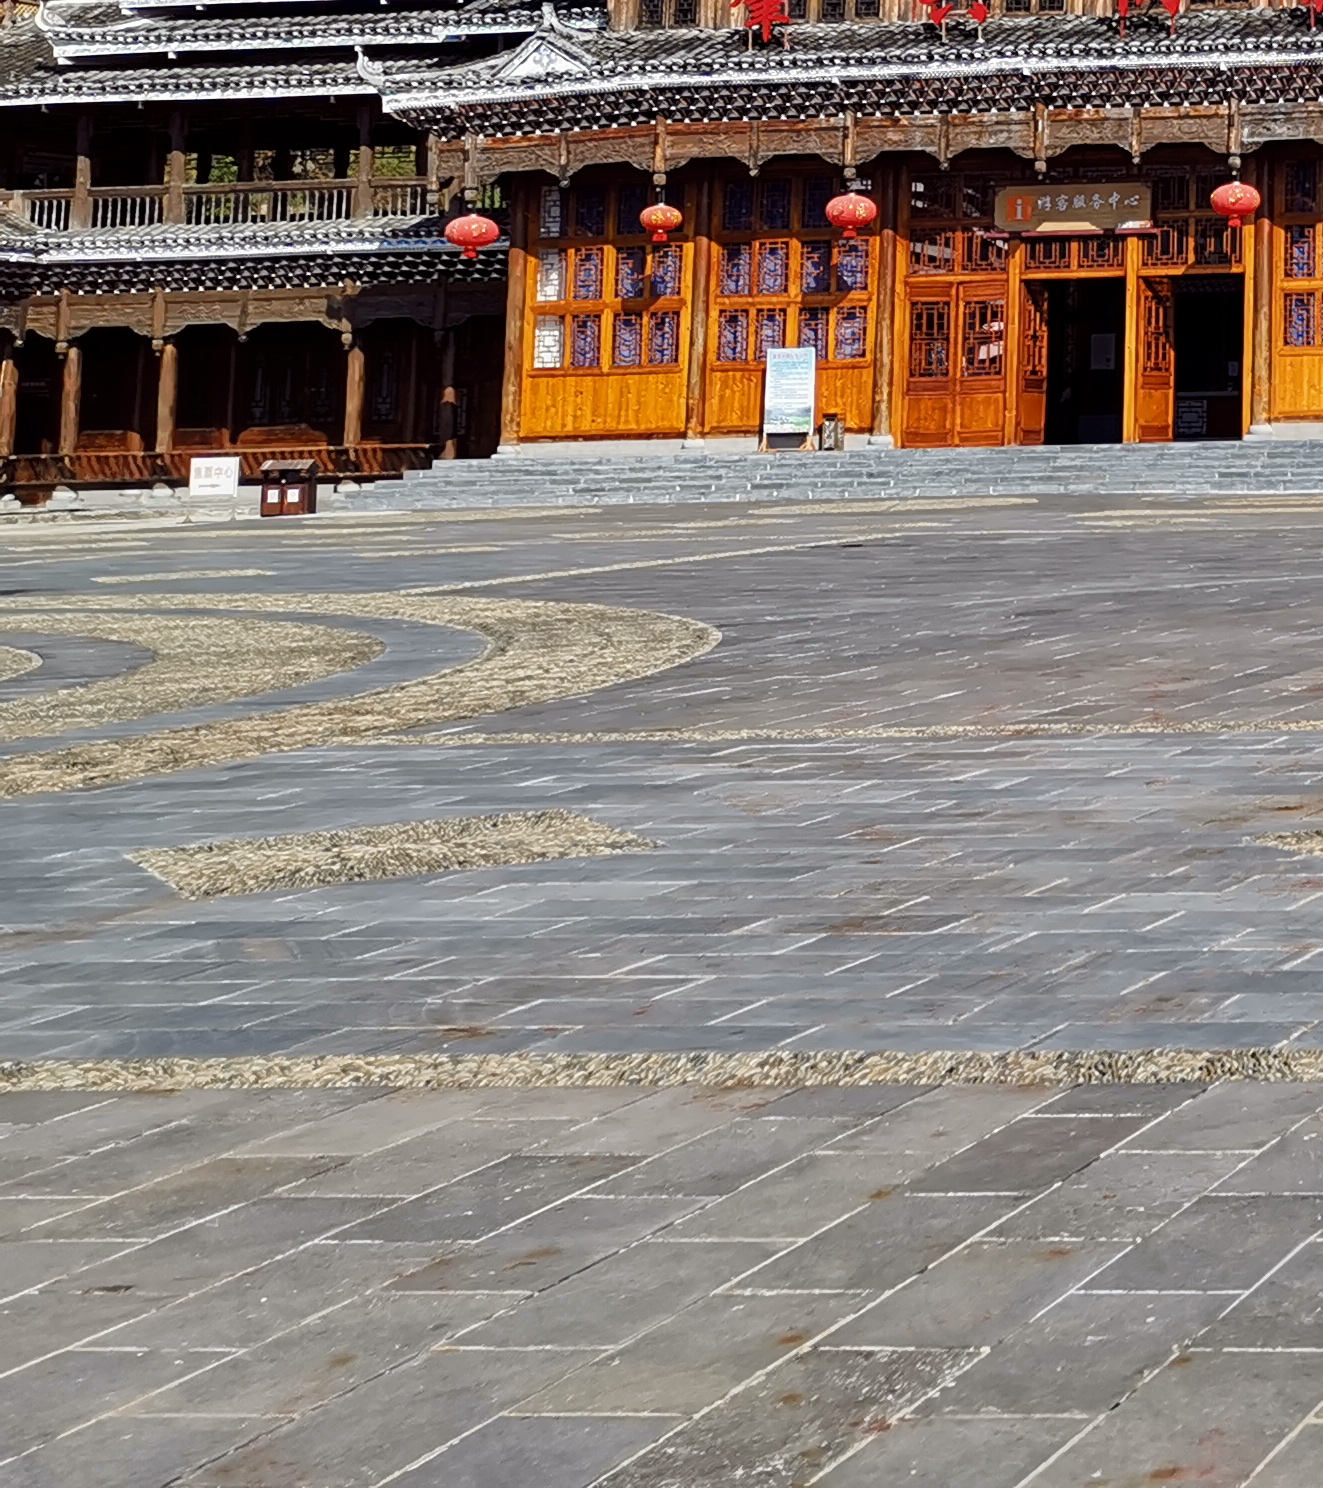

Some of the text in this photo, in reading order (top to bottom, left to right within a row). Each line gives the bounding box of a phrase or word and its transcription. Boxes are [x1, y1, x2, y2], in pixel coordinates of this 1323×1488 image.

[1037, 191, 1140, 212] 游客服务中心
